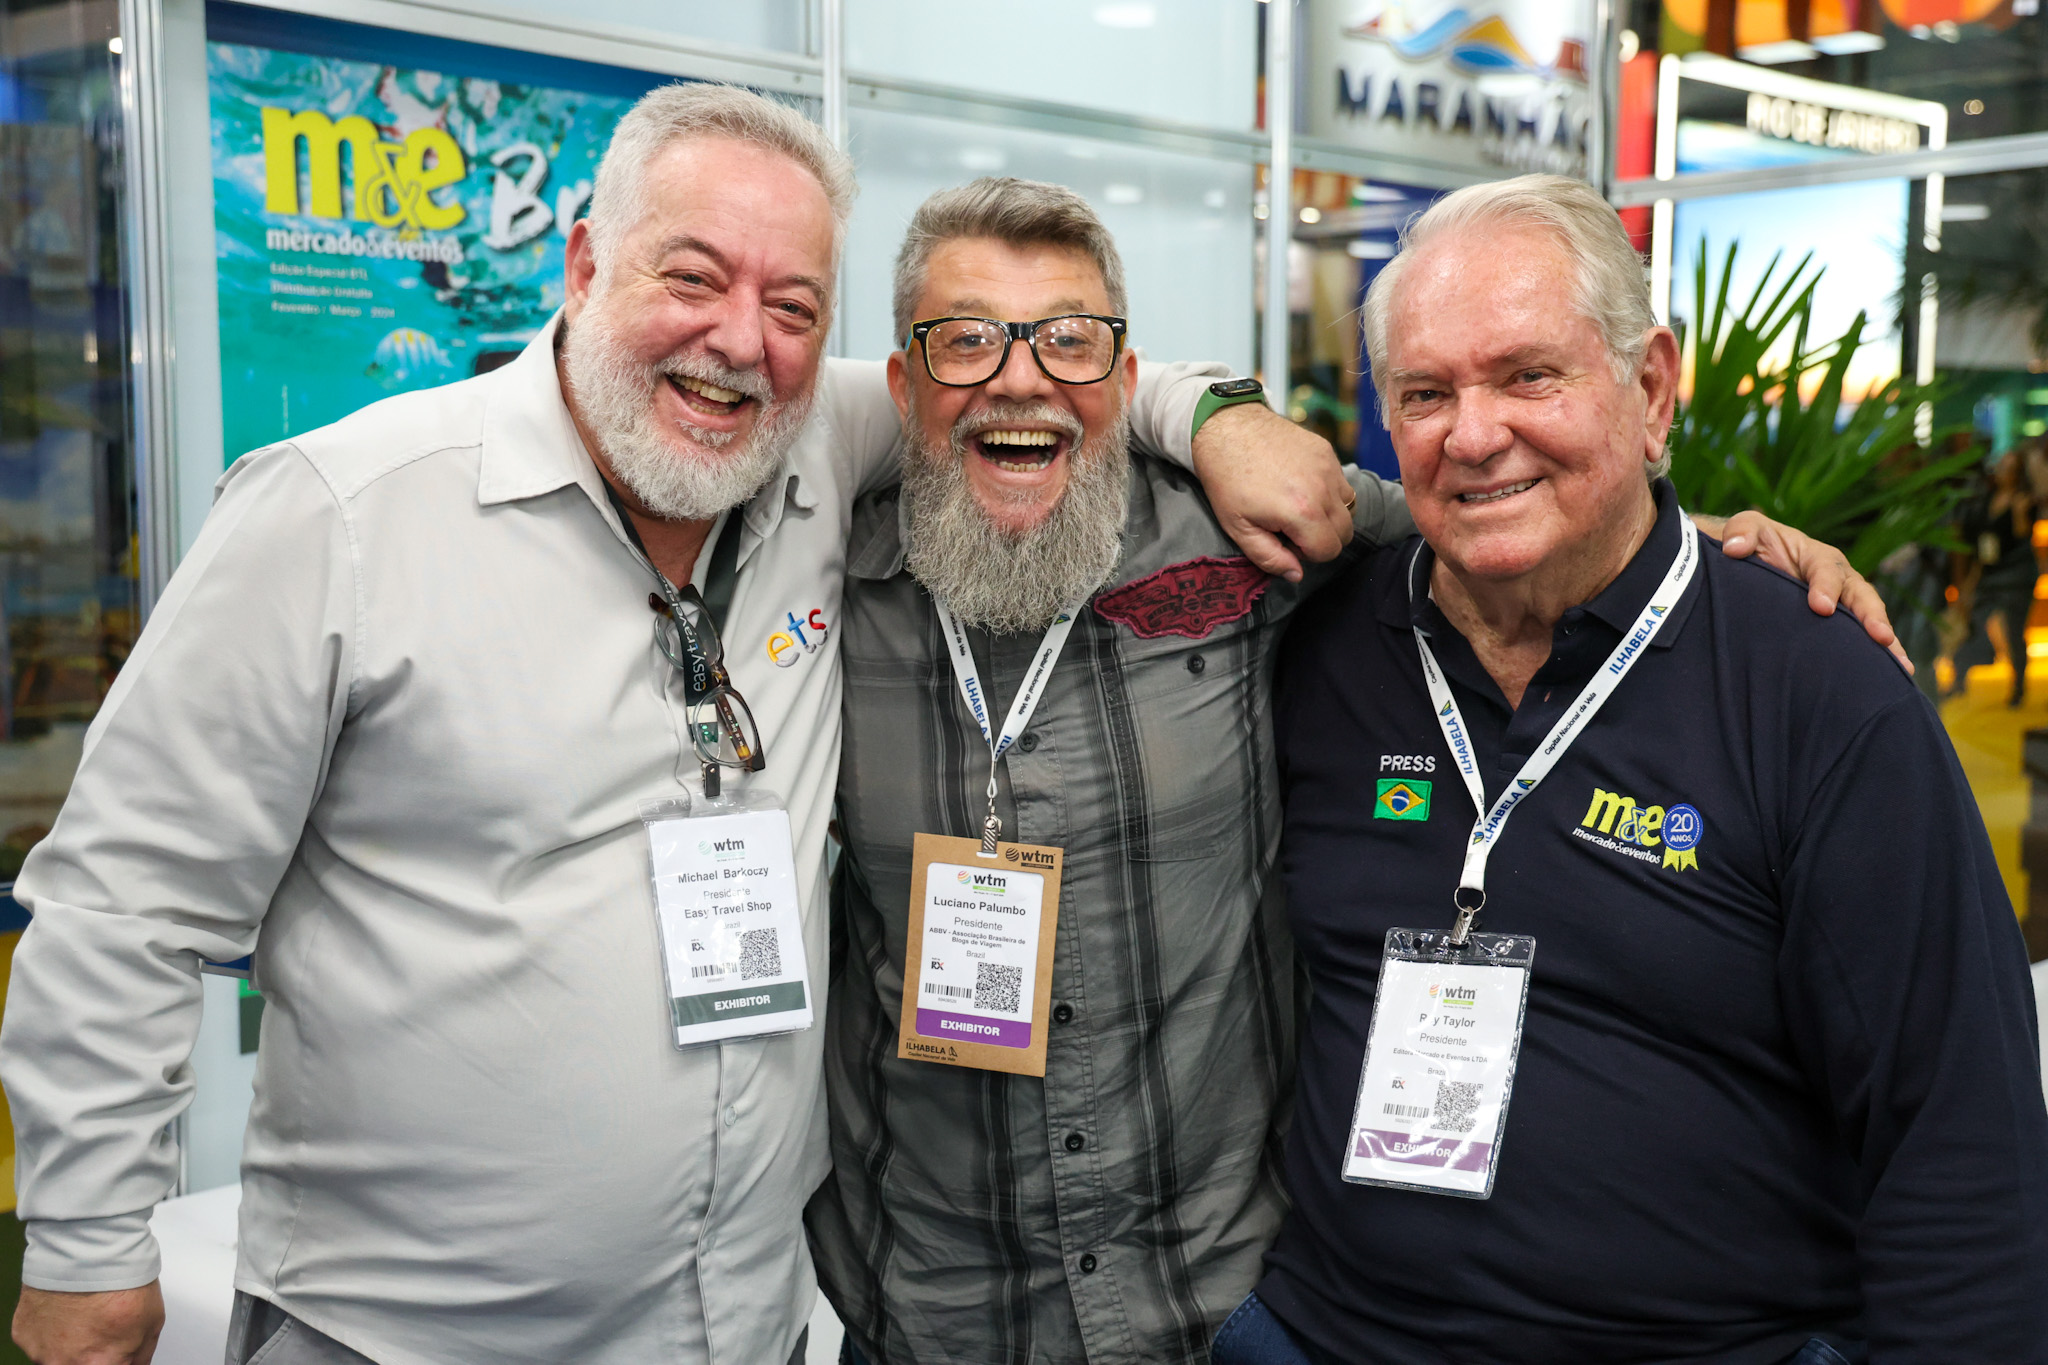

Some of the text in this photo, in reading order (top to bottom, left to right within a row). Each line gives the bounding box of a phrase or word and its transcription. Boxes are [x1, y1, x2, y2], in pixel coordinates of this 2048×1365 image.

[261, 106, 467, 231] m&e
[266, 228, 465, 265] mercado&eventos
[767, 608, 829, 669] ets
[1608, 618, 1656, 675] ILHABELA
[1040, 648, 1053, 669] Capital
[964, 677, 988, 736] ILHABELA
[1544, 692, 1597, 755] Capital Nacional da Vela
[1446, 716, 1474, 775] ILHABELA
[1379, 754, 1436, 773] PRESS
[1581, 788, 1666, 848] m&e
[1670, 813, 1694, 833] 20
[713, 838, 745, 851] wtm
[1572, 826, 1661, 865] mercado&eventos
[1670, 833, 1693, 843] ANOS
[1021, 850, 1055, 864] wtm
[678, 867, 769, 884] Michael Barkoczy
[974, 873, 1007, 888] wtm
[685, 901, 772, 919] Easy Travel Shop
[934, 896, 1026, 916] Luciano Palumbo
[724, 921, 741, 929] razil
[954, 916, 1003, 931] Presidente
[929, 927, 948, 935] ABBV
[952, 930, 988, 941] Associação
[988, 934, 1017, 944] Brasileira
[952, 936, 969, 945] Blogs
[979, 940, 1002, 949] Viagem
[966, 950, 986, 959] Brazil
[931, 960, 944, 971] RX
[1445, 986, 1476, 1000] wtm
[714, 994, 771, 1012] EXHIBITOR
[940, 1019, 1001, 1037] EXHIBITOR
[1420, 1013, 1476, 1028] Ry Taylor
[905, 1041, 946, 1055] ILHABELA
[1419, 1033, 1467, 1047] Presidente
[1393, 1047, 1414, 1056] Editora
[1446, 1053, 1470, 1062] Eventos
[1391, 1079, 1405, 1090] RX
[1393, 1141, 1452, 1158] EXHOR
